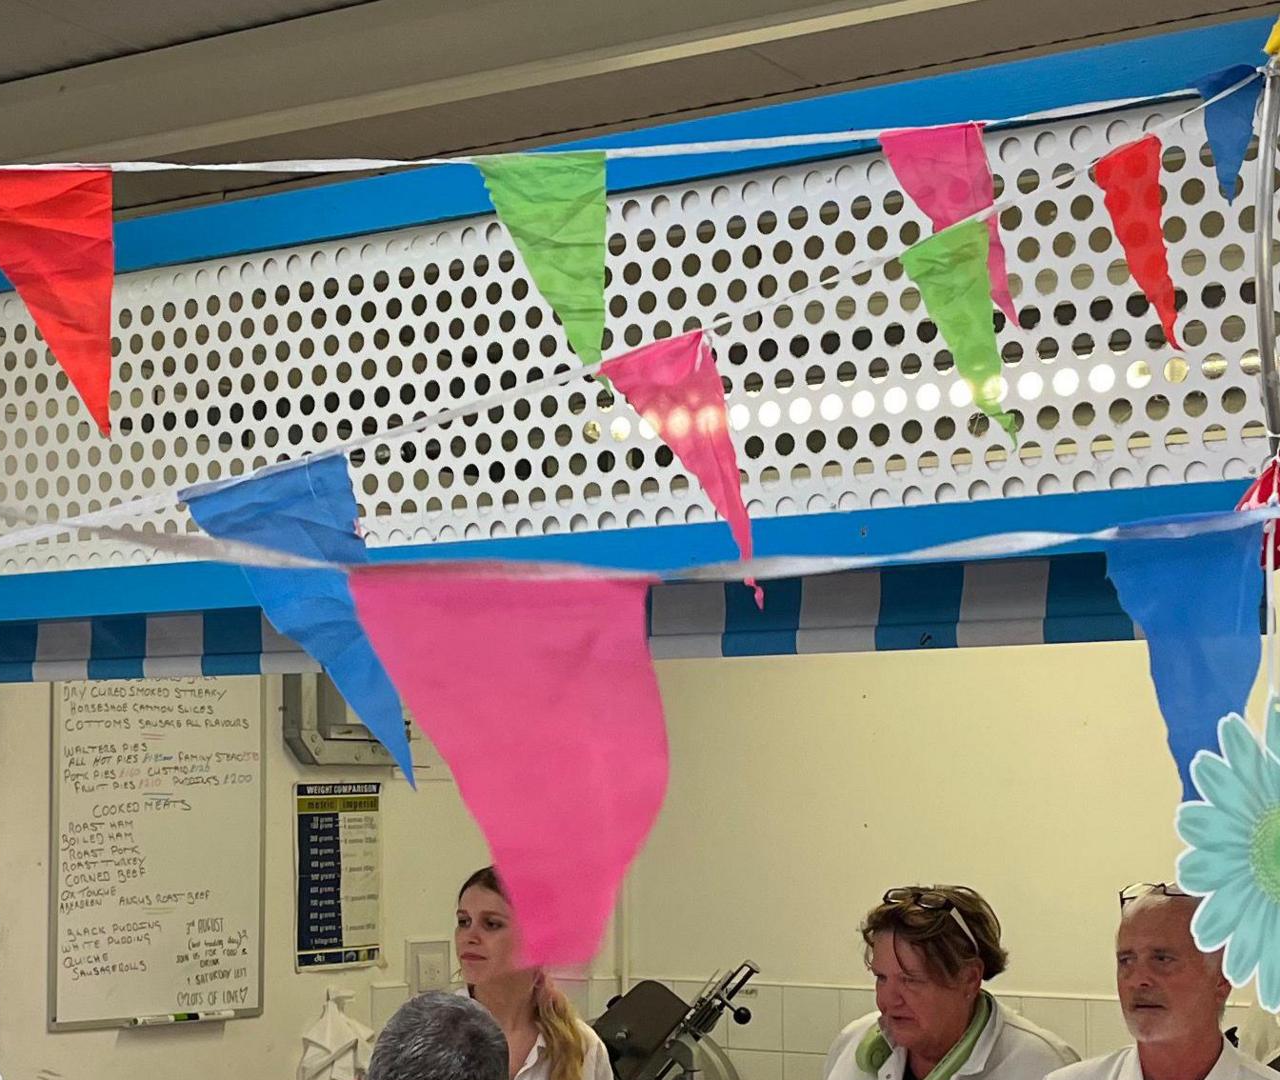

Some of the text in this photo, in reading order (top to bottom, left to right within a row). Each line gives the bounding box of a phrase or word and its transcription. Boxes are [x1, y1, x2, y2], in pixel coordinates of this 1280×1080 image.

[63, 685, 228, 702] DRY CURED SMOKED STREAKY
[70, 702, 128, 714] HORSESHOE
[177, 704, 214, 715] SLICES
[138, 718, 182, 730] SAUSAGE
[204, 718, 250, 730] FLAVOURS
[63, 742, 148, 758] WALTERS PIES
[116, 754, 139, 765] PIES
[93, 768, 117, 780] PIES
[112, 780, 137, 792] PIES
[306, 784, 377, 794] WEIGHT COMPARISON
[92, 799, 192, 819] COOKED MEATS
[342, 799, 377, 811] imperial
[68, 820, 134, 834] ROAST HAM
[60, 832, 134, 851] BOILED HAM
[68, 848, 105, 860] ROAST
[62, 861, 99, 873] ROAST
[64, 867, 146, 888] CORNED BEEF
[119, 895, 153, 906] ANGUS
[186, 889, 211, 905] BEEF
[66, 920, 163, 943] BLACK PUDDING
[197, 917, 224, 933] AUGUST
[106, 932, 152, 945] PUDDING
[63, 952, 109, 969] QUICHE
[71, 960, 148, 981] SAUSAGE ROLLS
[194, 968, 232, 986] SATURDAY
[206, 990, 219, 1006] OF
